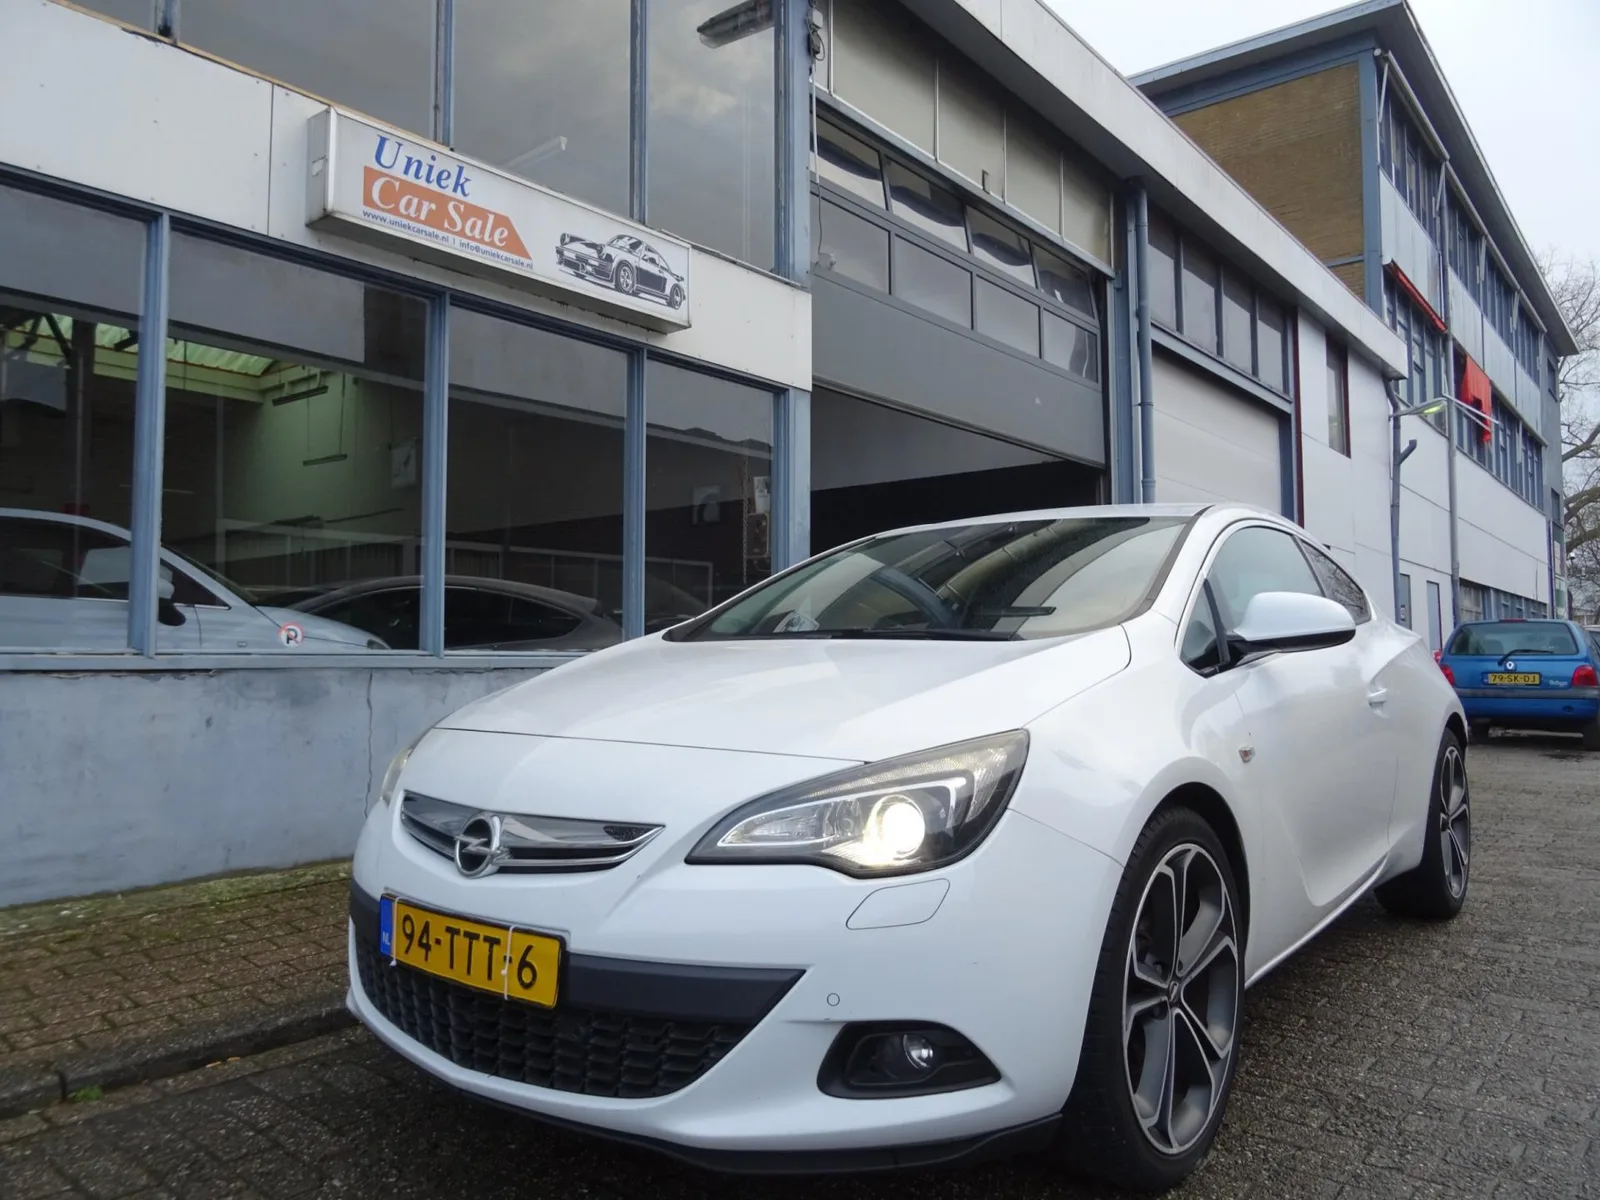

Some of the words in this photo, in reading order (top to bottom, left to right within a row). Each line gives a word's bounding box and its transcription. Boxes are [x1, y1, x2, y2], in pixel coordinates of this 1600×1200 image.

[374, 134, 472, 198] Uniek
[362, 209, 450, 243] www.uniekcarsale.nl
[459, 239, 534, 270] info@uniekcarsale.nl
[371, 176, 437, 221] Car
[444, 200, 509, 247] Sale
[402, 913, 538, 990] 94-TTT-6
